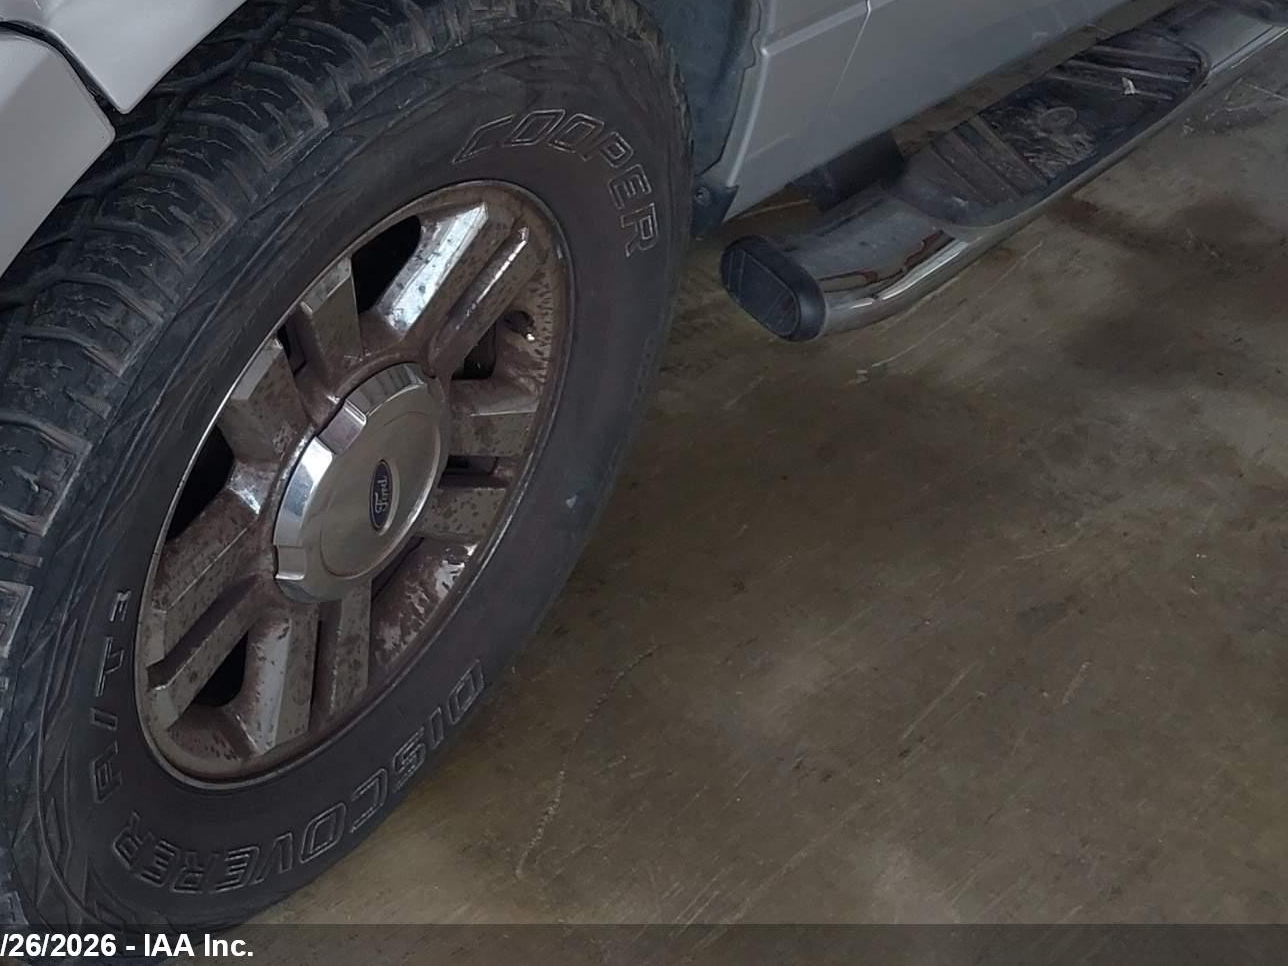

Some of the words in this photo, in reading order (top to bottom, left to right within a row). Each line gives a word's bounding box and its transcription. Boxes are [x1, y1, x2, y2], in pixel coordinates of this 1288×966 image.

[452, 109, 658, 258] COOPER
[374, 475, 389, 515] Ford
[112, 658, 486, 894] DISCOVERER
